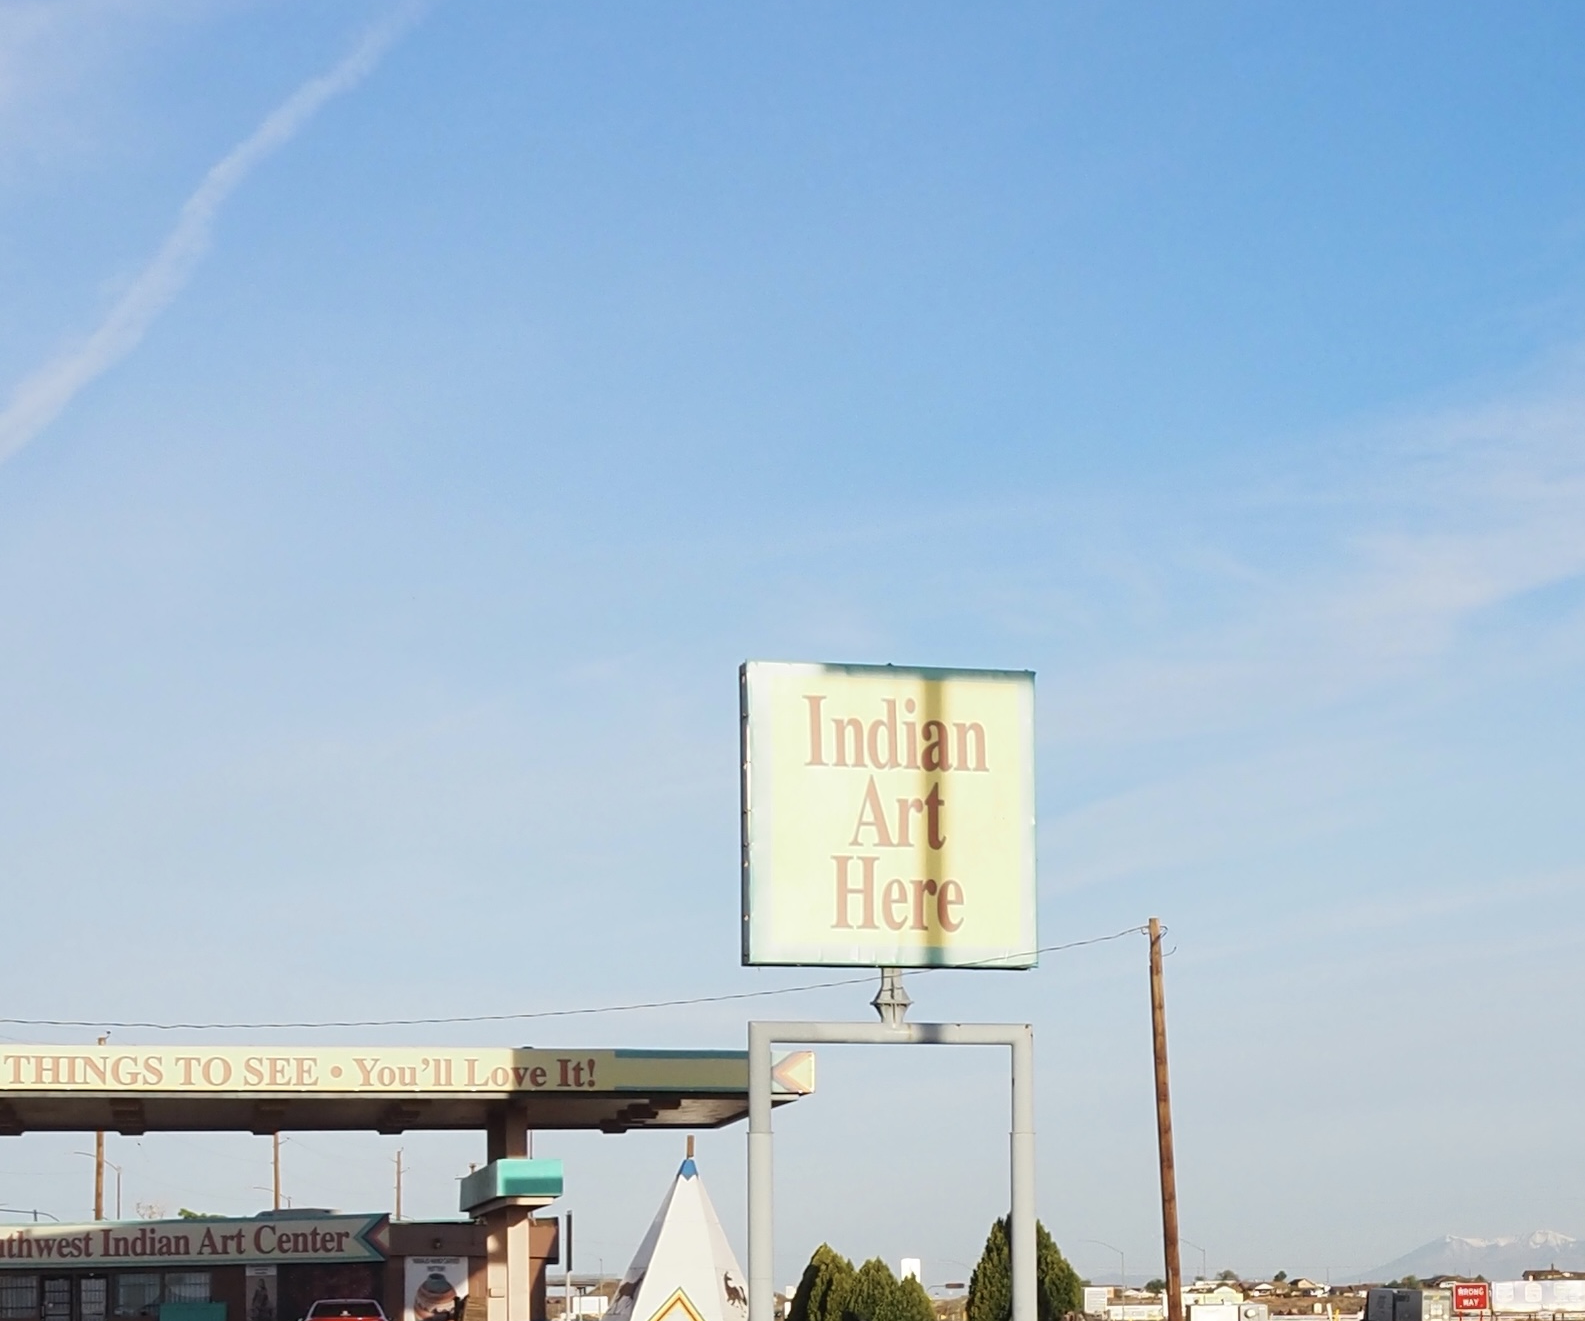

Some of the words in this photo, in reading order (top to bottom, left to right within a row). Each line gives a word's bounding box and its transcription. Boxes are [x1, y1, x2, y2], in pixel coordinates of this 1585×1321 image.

[802, 694, 989, 773] Indian
[849, 775, 947, 850] Art
[830, 855, 965, 932] Here
[3, 1055, 163, 1085] THINGS
[174, 1056, 232, 1086] TO
[243, 1056, 319, 1086] SEE
[352, 1057, 454, 1087] You'll
[464, 1058, 547, 1087] Love
[556, 1058, 596, 1088] It!
[102, 1229, 190, 1258] Indian
[199, 1223, 246, 1257] Art
[254, 1225, 349, 1255] Center
[1457, 1287, 1484, 1296] WRONG
[1462, 1299, 1479, 1307] WAY
